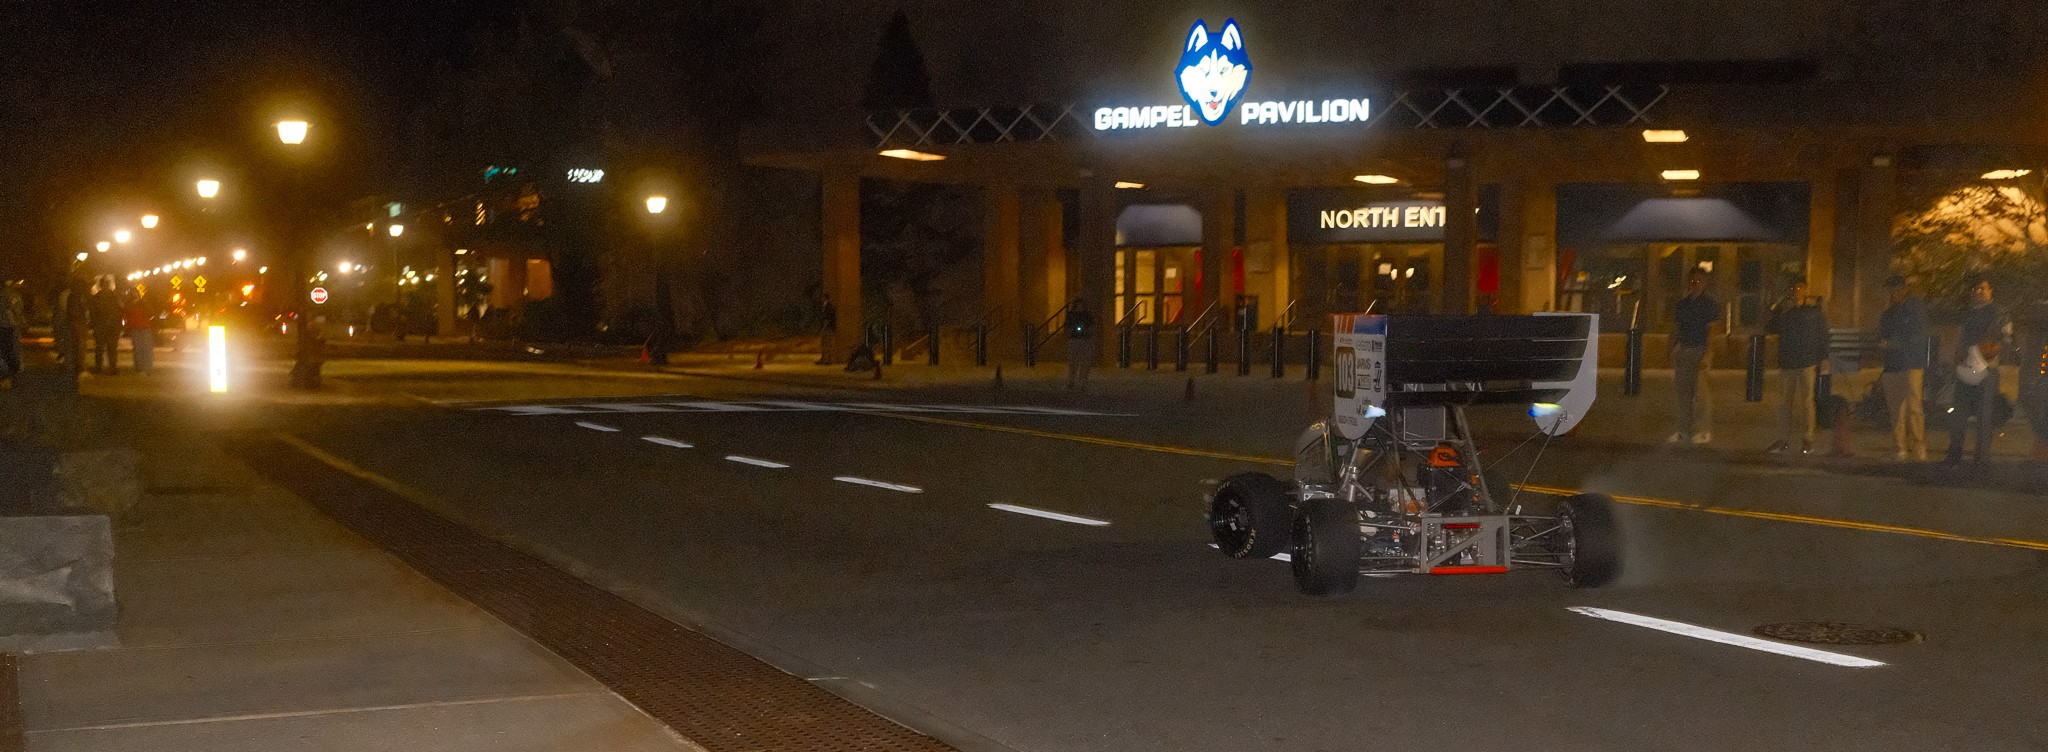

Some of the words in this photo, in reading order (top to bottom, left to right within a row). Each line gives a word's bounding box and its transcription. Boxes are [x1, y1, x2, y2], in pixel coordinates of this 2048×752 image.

[1094, 106, 1199, 130] GAMPEL
[1241, 98, 1369, 125] PAVILION
[1320, 206, 1399, 228] NORTH
